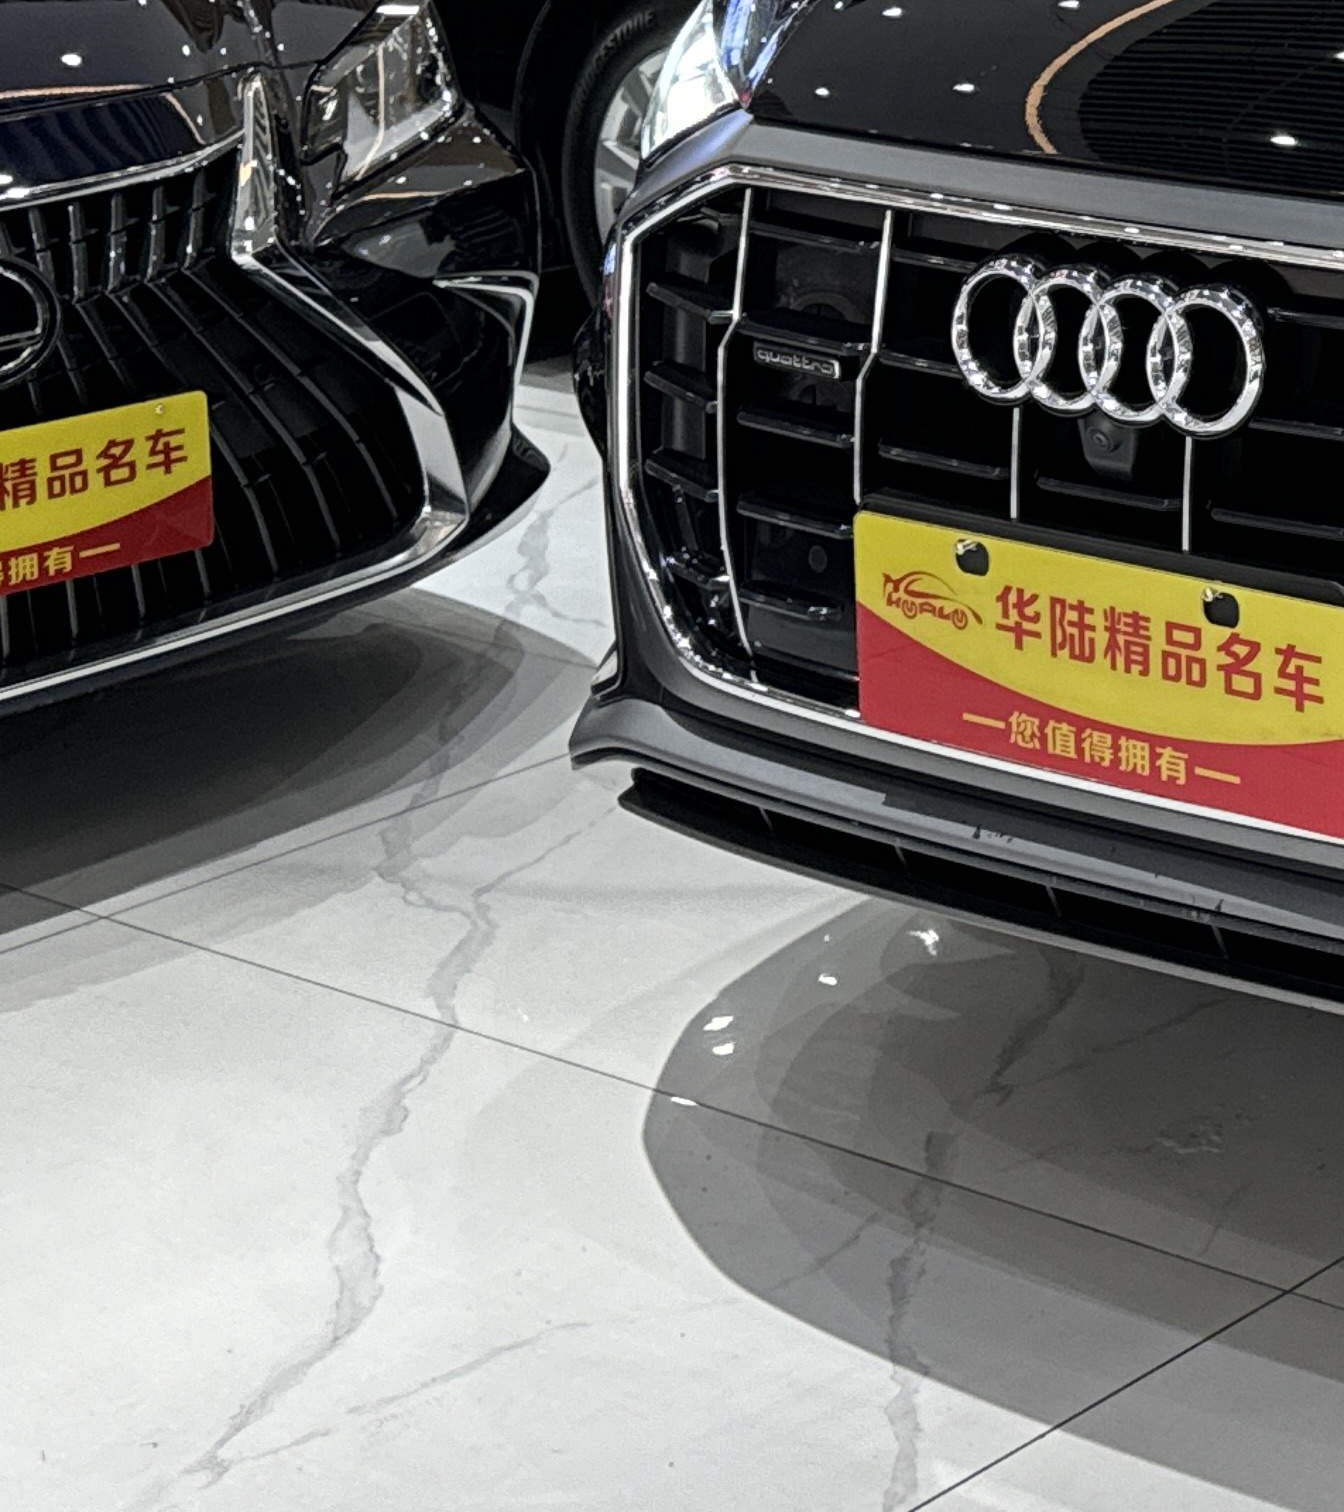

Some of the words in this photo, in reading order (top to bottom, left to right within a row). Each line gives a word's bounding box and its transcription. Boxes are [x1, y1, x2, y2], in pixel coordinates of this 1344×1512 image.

[757, 349, 834, 375] quattro
[0, 427, 188, 511] 精品名车
[995, 584, 1325, 714] 华陆精品名车
